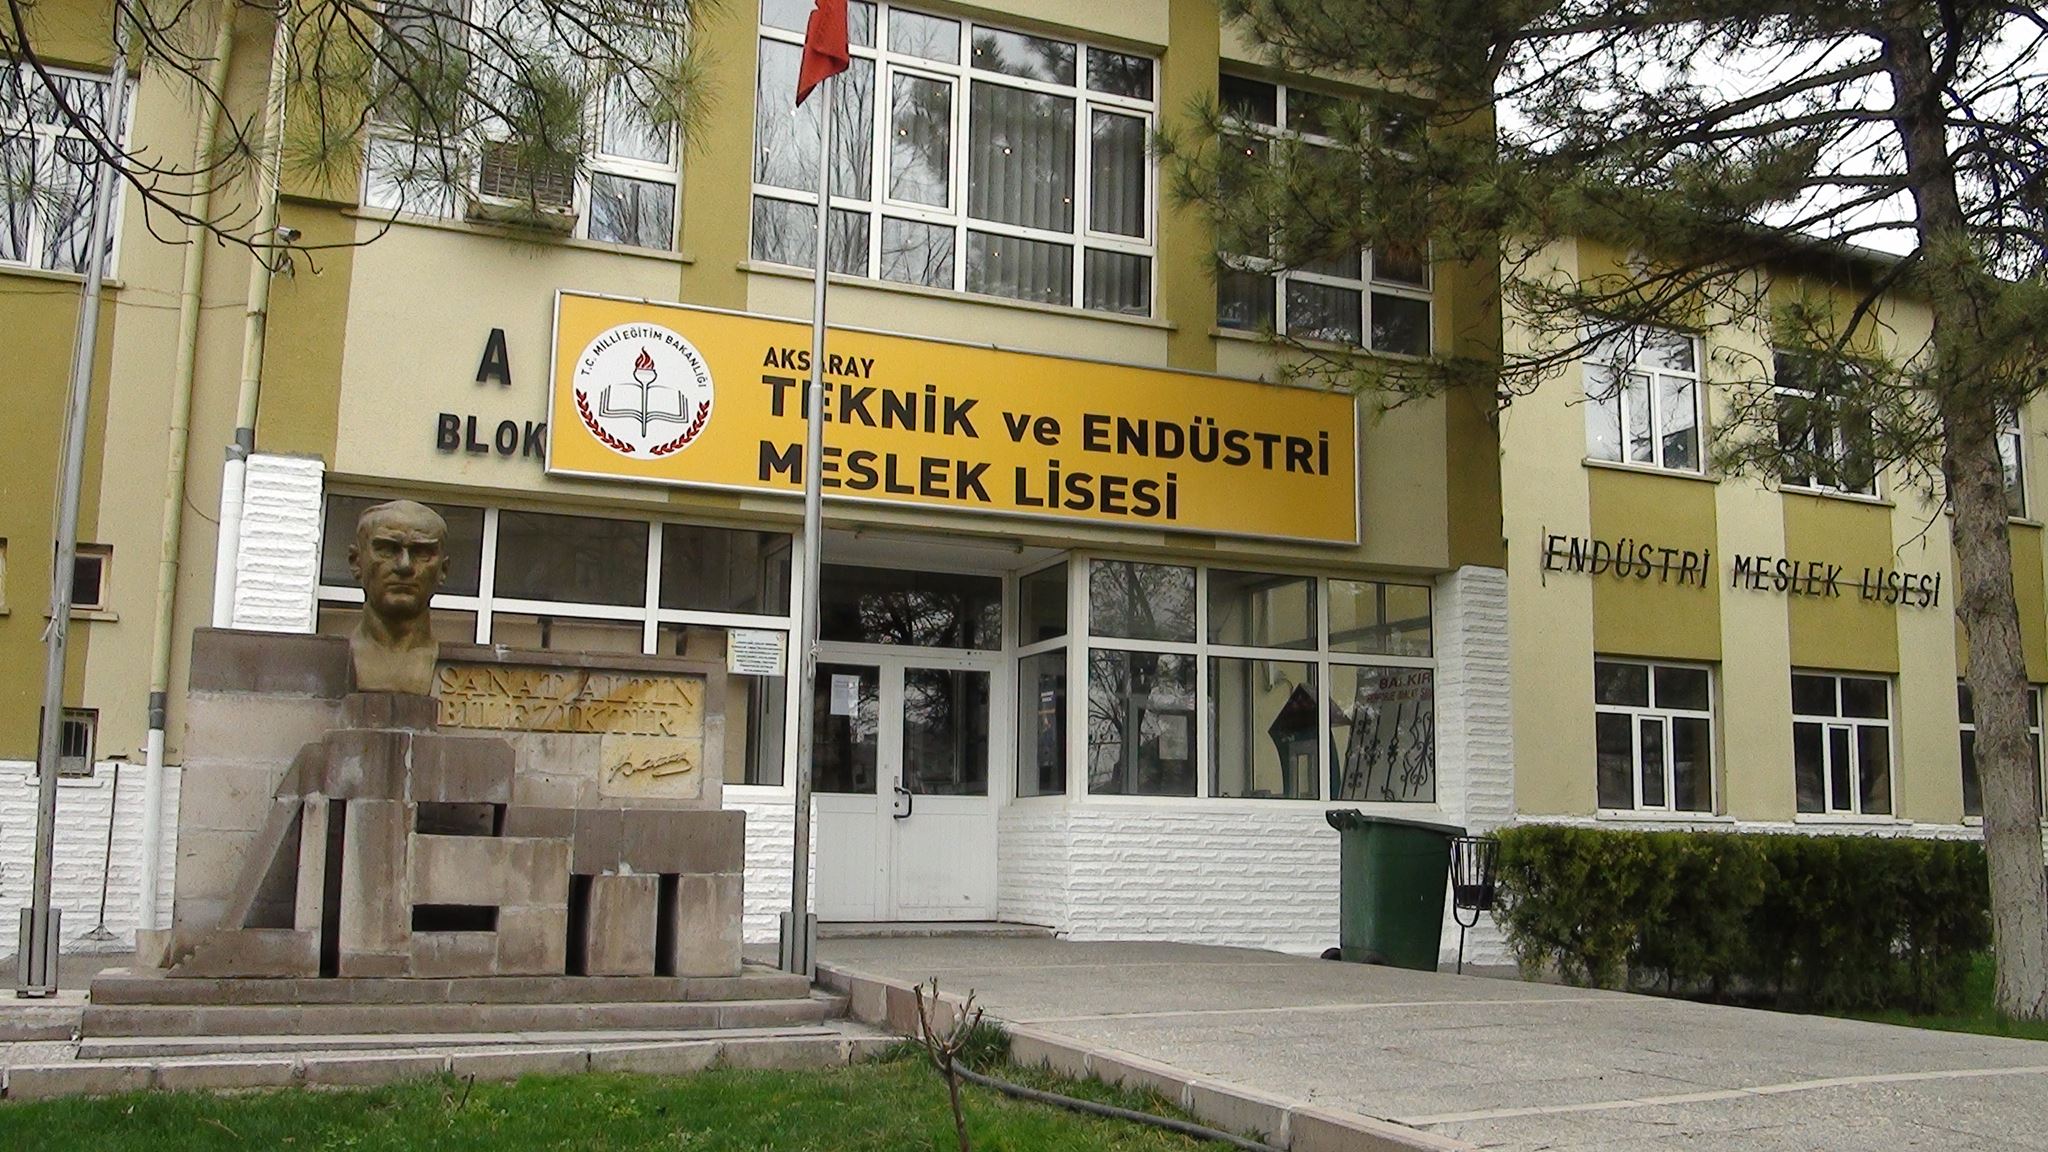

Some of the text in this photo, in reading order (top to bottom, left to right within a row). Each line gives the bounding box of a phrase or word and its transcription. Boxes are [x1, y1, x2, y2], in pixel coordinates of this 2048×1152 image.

[475, 327, 512, 386] A
[593, 330, 621, 357] MİLLİ
[622, 326, 662, 341] EĞİTİM
[665, 335, 707, 388] BAKANLIĞI
[763, 346, 875, 379] AKSRAY
[436, 412, 549, 458] BLOK
[762, 374, 1330, 476] TEKNİK ve ENDÜSTRİ
[759, 440, 1178, 520] MESLEK LİSESİ
[1543, 534, 1711, 590] ENDÜSTRİ
[1732, 554, 1843, 598] MESLEK
